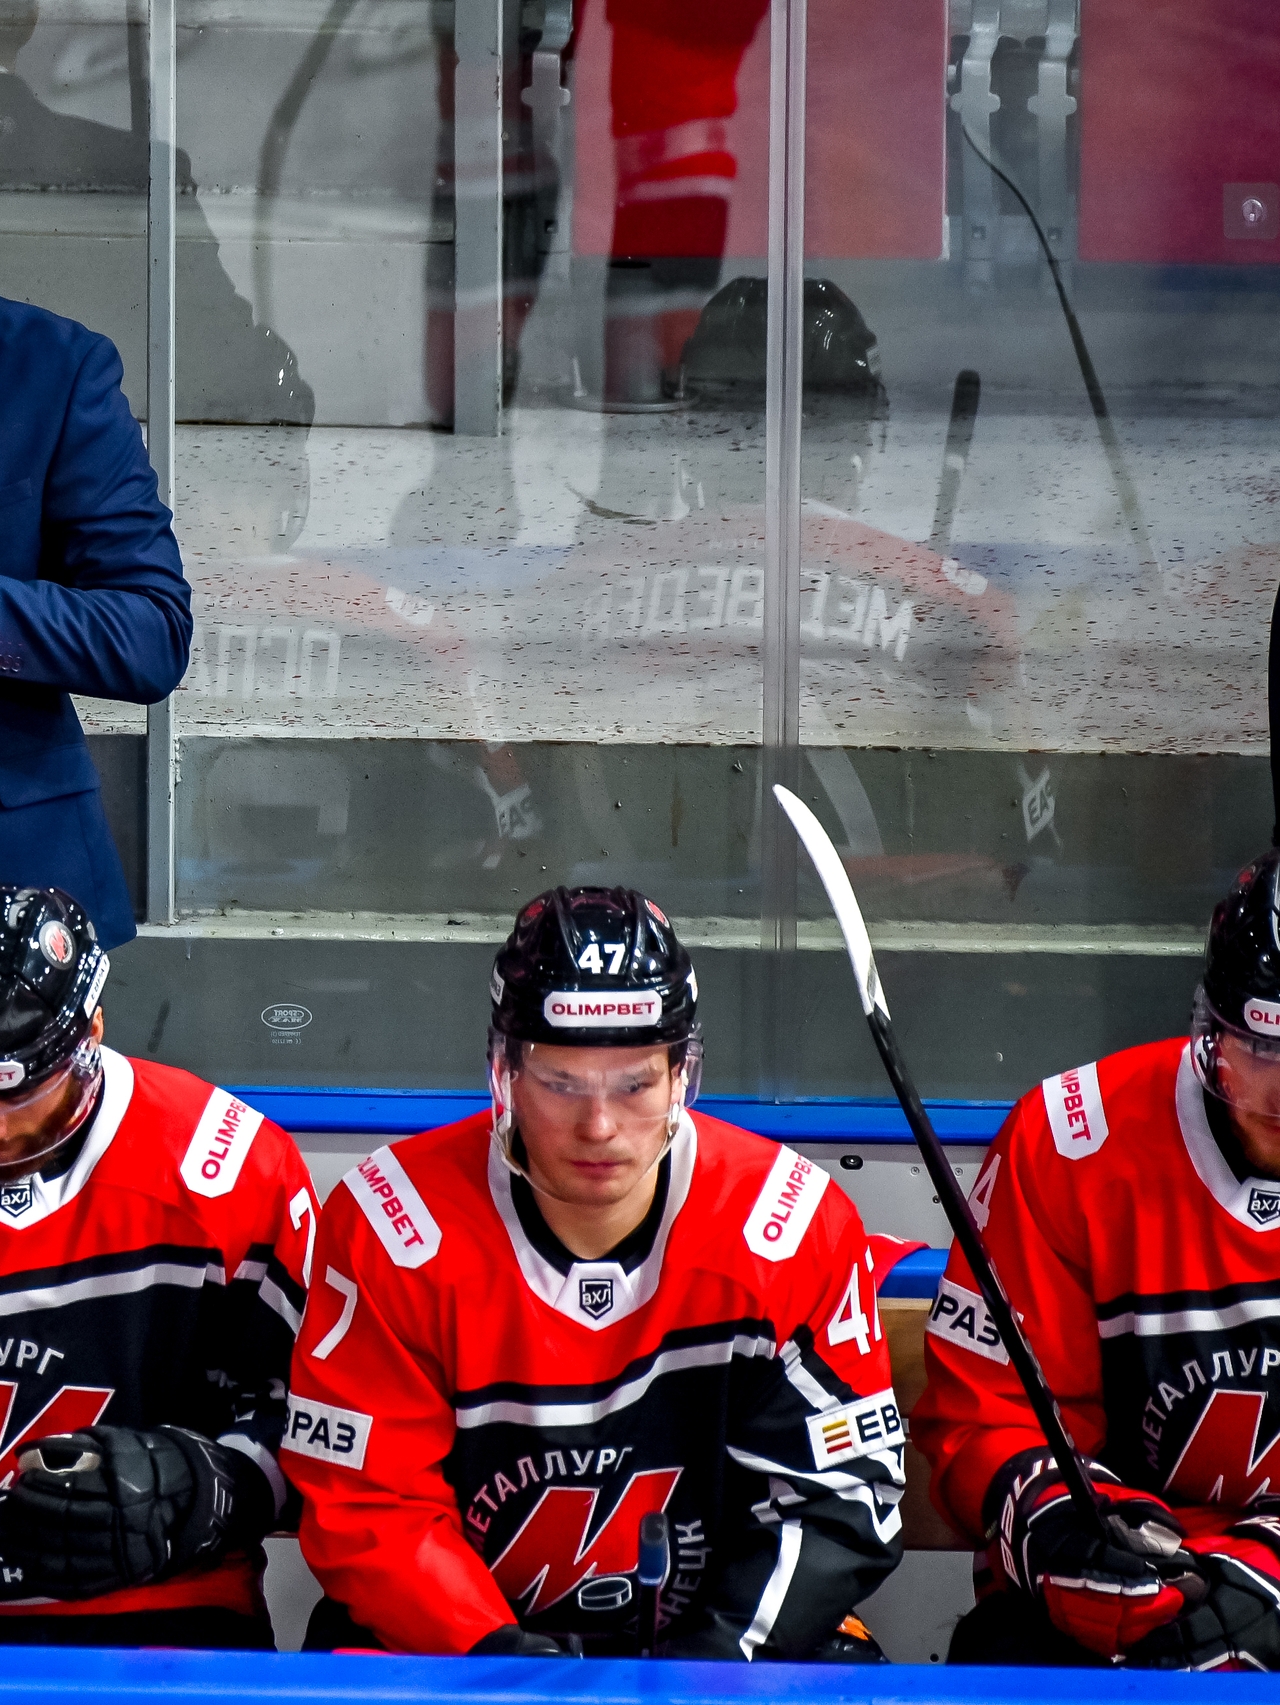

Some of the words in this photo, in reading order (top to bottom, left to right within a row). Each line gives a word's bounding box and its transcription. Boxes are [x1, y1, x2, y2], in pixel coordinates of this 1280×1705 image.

[578, 943, 626, 975] 47
[551, 1002, 655, 1016] OLIMPBET
[311, 1264, 358, 1360] 7
